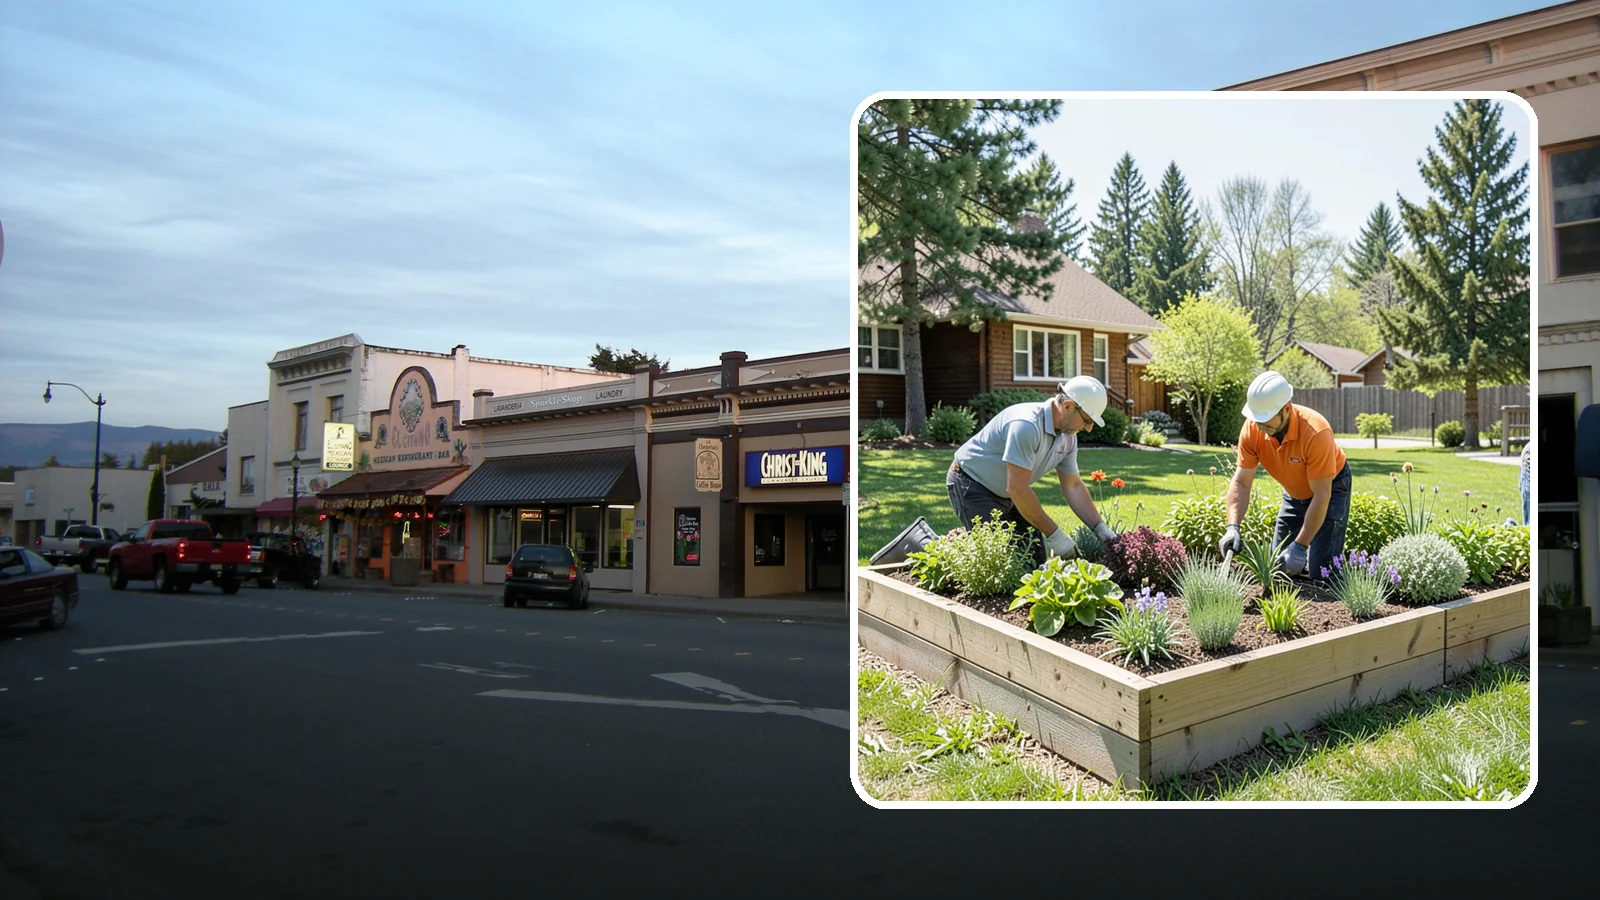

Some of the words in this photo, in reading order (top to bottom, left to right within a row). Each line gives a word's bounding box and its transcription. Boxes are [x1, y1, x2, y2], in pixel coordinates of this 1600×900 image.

[595, 389, 623, 400] LAUNDRY
[493, 402, 522, 413] LAVANDERIA
[397, 451, 434, 463] RESTAURANT
[437, 450, 450, 459] BAR
[761, 452, 797, 478] CHRIST
[799, 450, 827, 476] KING
